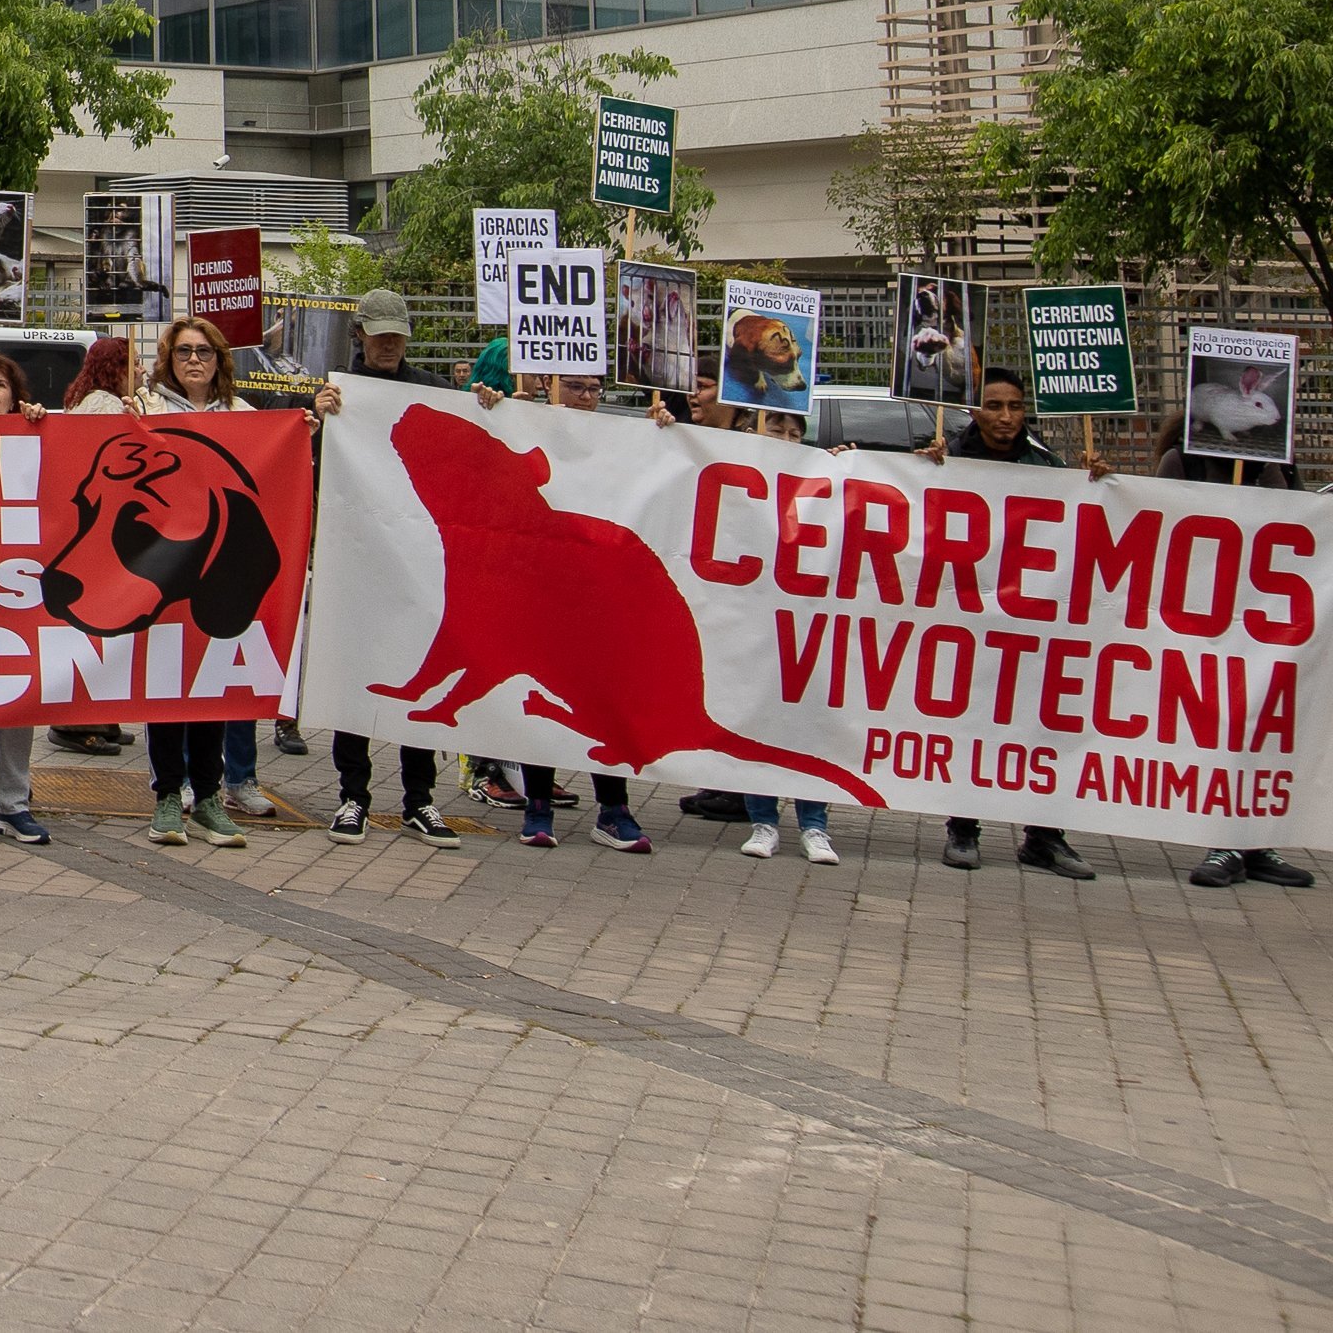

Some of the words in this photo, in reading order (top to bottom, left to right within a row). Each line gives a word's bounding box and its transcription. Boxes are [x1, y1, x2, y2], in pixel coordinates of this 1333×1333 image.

[602, 111, 666, 136] CERREMOS
[601, 131, 670, 156] VIVOTECNIA
[600, 150, 624, 169] POR
[627, 154, 649, 172] LOS
[599, 170, 659, 194] ANIMALES
[480, 218, 548, 236] ¡GRACIAS
[481, 241, 490, 258] Y
[193, 260, 233, 276] DEJEMOS
[194, 283, 206, 296] LA
[207, 275, 259, 295] VIVISECCIÓN
[517, 264, 595, 305] END
[729, 285, 741, 293] En
[743, 287, 751, 295] la
[754, 288, 815, 303] investigación
[195, 299, 207, 314] EN
[208, 298, 219, 312] EL
[221, 295, 254, 310] PASADO
[273, 297, 288, 306] DE
[290, 298, 360, 312] VIVOTECNI
[729, 295, 746, 305] NO
[749, 297, 782, 309] TODO
[785, 301, 815, 314] VALE
[1031, 304, 1115, 325] CERREMOS
[23, 331, 75, 341] UPR-23B
[518, 316, 597, 338] ANIMAL
[1033, 328, 1124, 348] VIVOTECNIA
[1193, 333, 1205, 342] En
[1209, 334, 1217, 343] la
[1221, 335, 1290, 348] investigación
[518, 341, 598, 362] TESTING
[1036, 352, 1067, 371] POR
[1070, 351, 1100, 370] LOS
[1193, 343, 1212, 353] NO
[1216, 344, 1253, 356] TODO
[1256, 347, 1290, 360] VALE
[249, 371, 295, 383] VÍCTIMA
[297, 376, 311, 384] DE
[312, 377, 325, 385] LA
[1038, 374, 1117, 394] ANIMALES
[102, 443, 181, 508] 32
[690, 462, 1316, 647] CERREMOS
[775, 609, 1299, 754] VIVOTECNIA
[864, 728, 952, 783] POR
[972, 738, 1057, 794] LOS
[1076, 751, 1292, 818] ANIMALES
